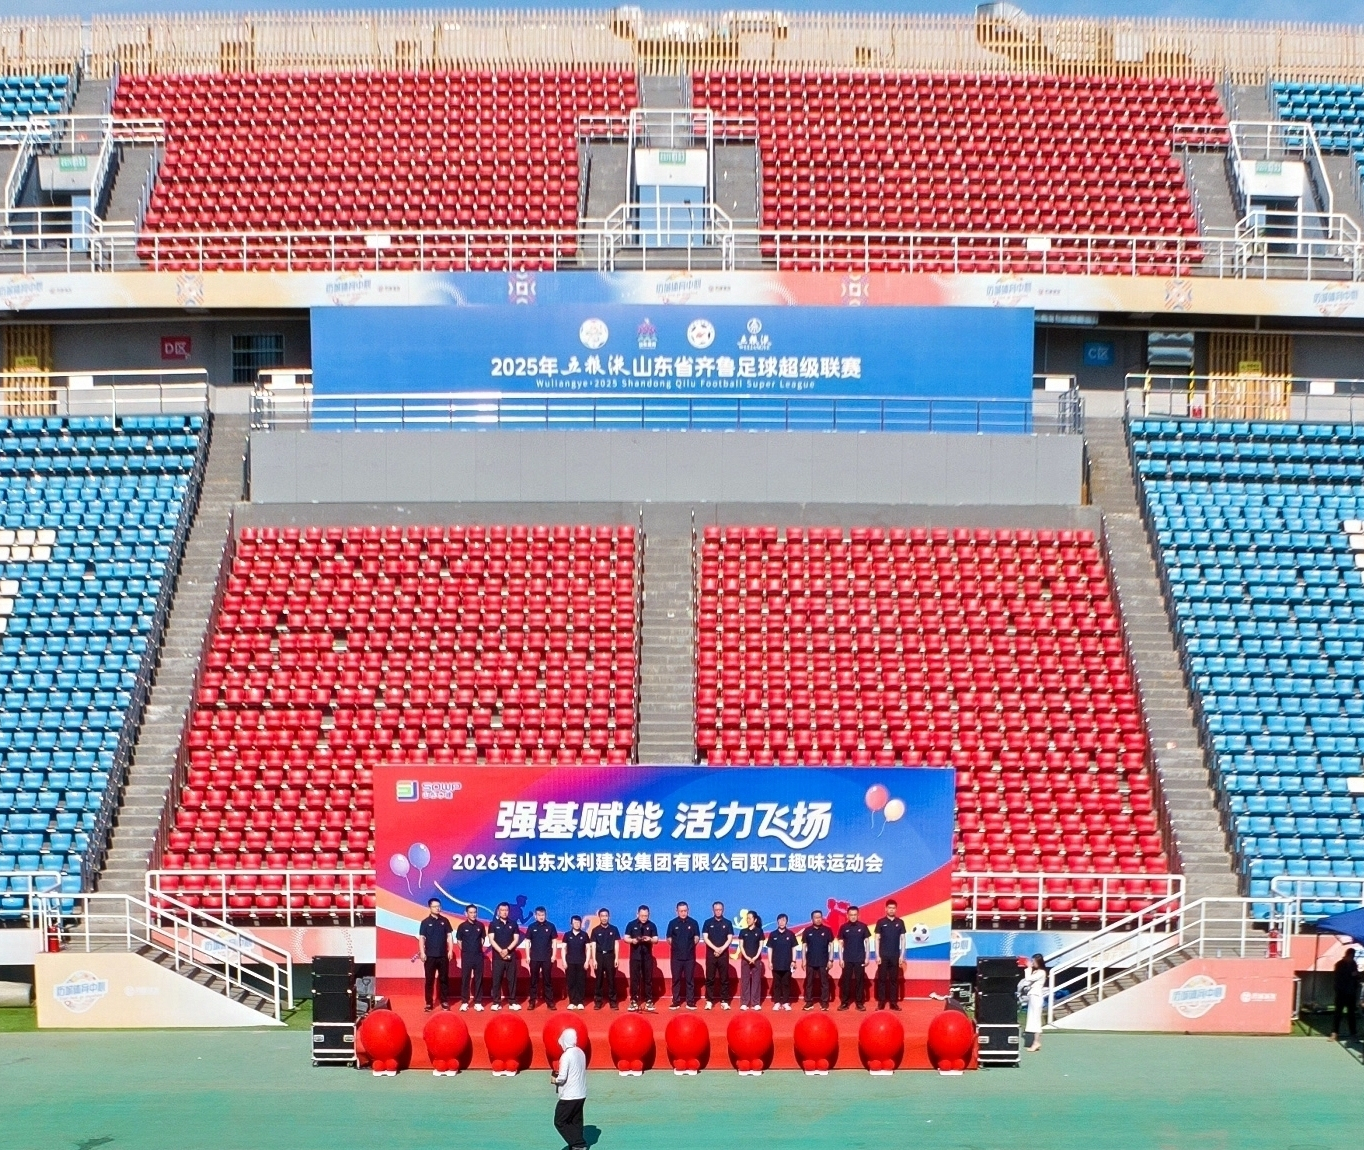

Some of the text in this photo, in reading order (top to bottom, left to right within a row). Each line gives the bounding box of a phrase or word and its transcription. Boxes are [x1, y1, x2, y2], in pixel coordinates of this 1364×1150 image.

[164, 340, 187, 356] D区
[1088, 346, 1109, 360] C区
[621, 379, 672, 389] Shandong
[675, 379, 696, 389] Qilu
[700, 379, 743, 388] Football
[746, 379, 776, 390] Super
[779, 380, 815, 390] League
[494, 800, 833, 850] 强基赋能 活力飞扬
[452, 852, 884, 873] 2026年山东水利建设集团有限公司职工趣味运动会
